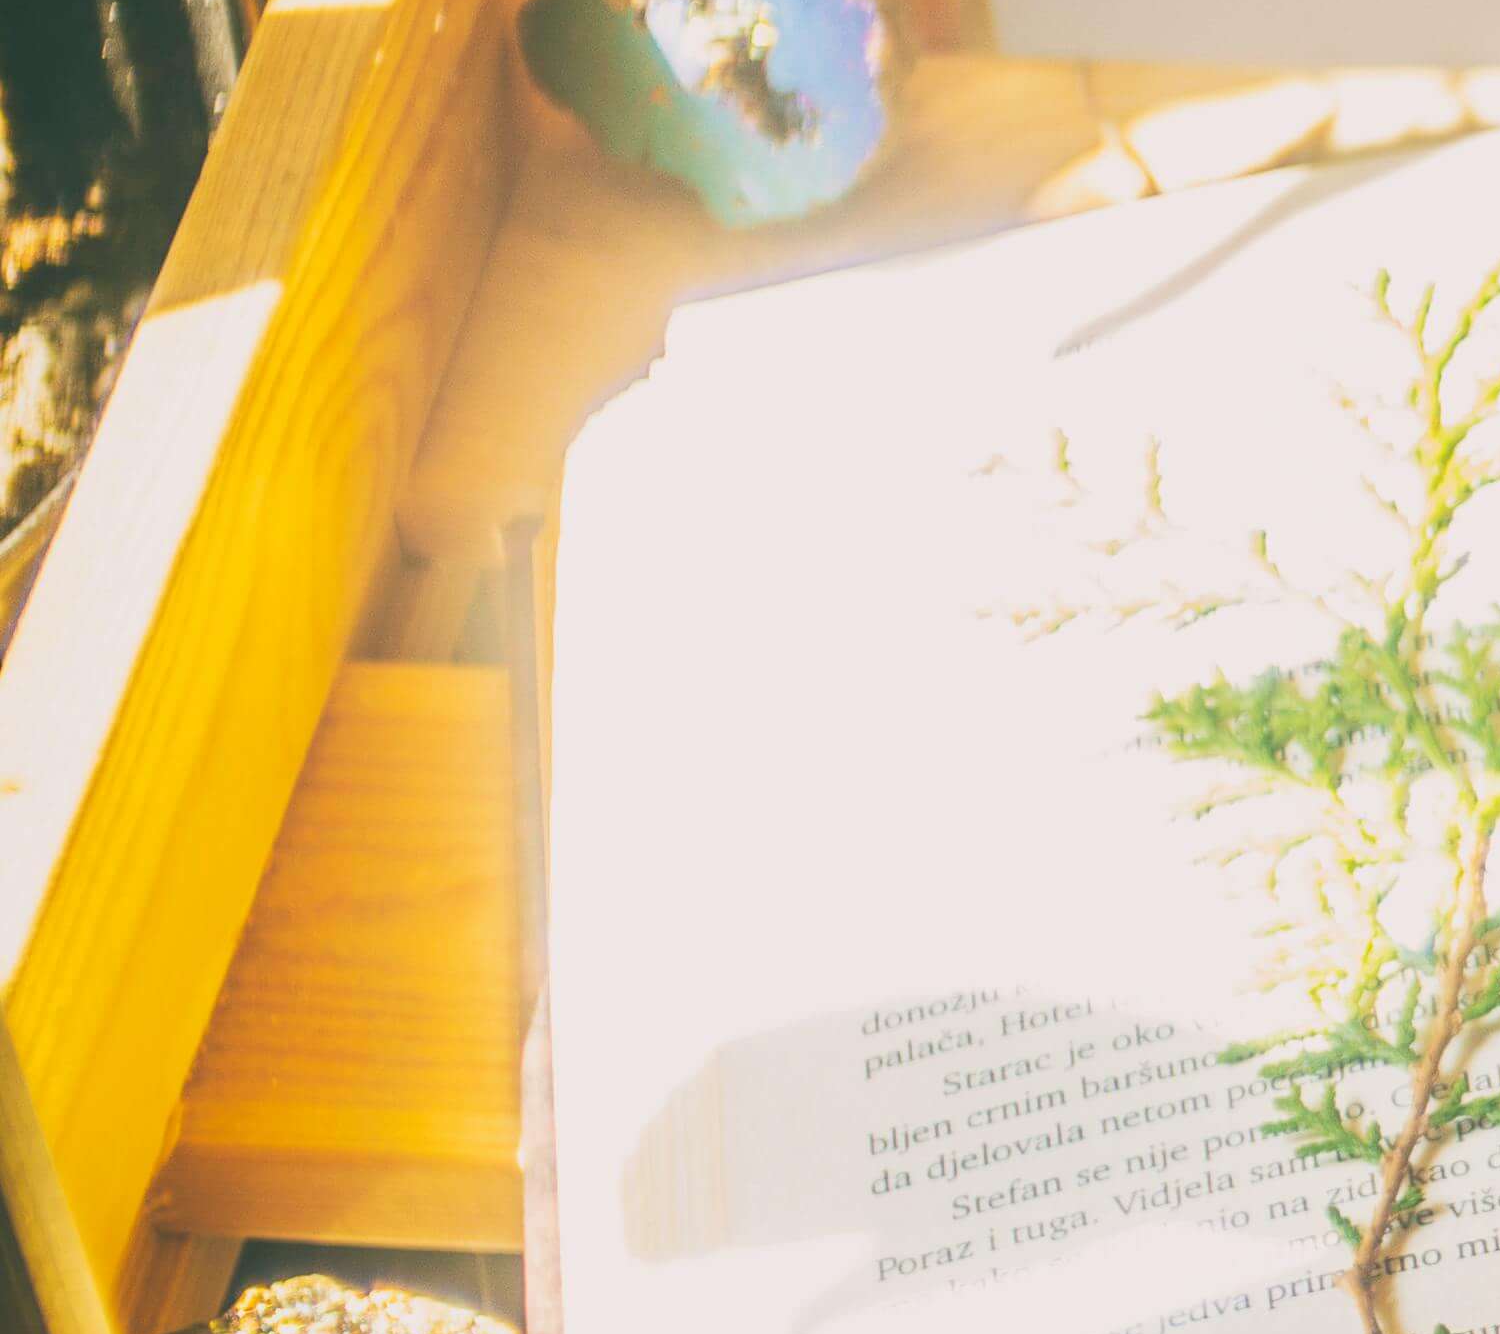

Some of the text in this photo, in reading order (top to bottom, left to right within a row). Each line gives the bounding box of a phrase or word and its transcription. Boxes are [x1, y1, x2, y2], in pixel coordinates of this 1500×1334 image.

[870, 1093, 1212, 1197] da djelovala netom
